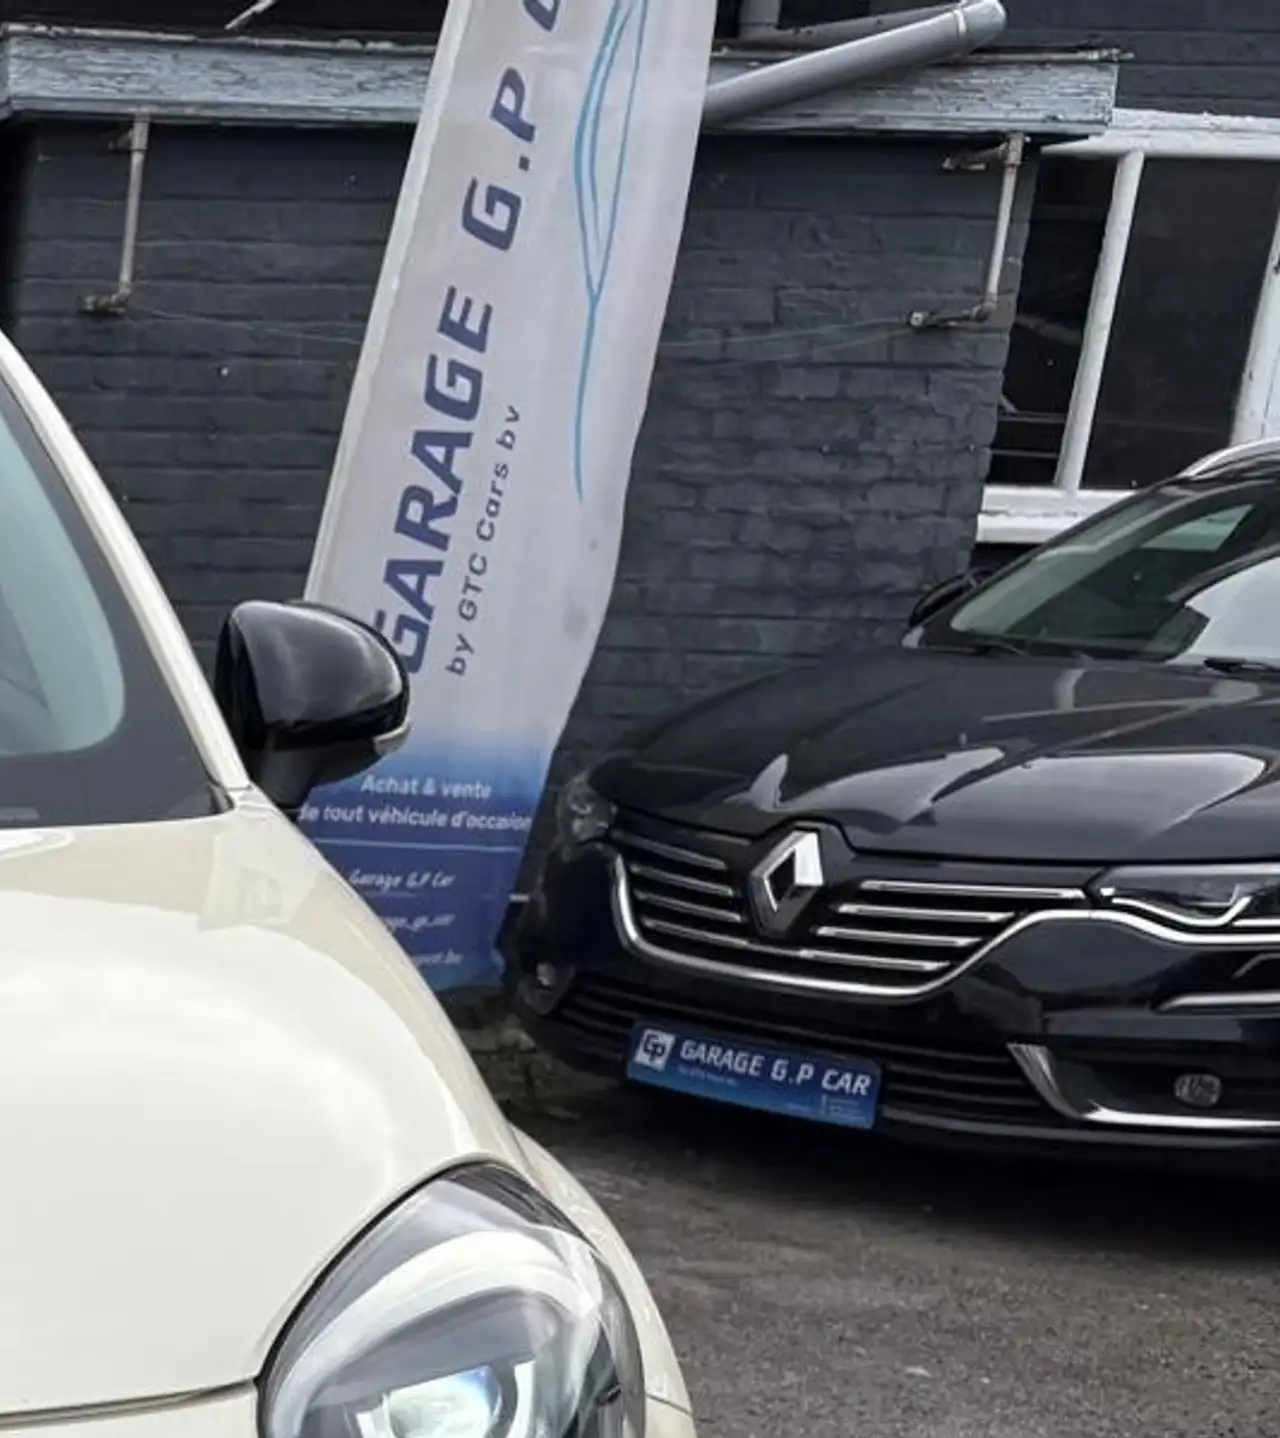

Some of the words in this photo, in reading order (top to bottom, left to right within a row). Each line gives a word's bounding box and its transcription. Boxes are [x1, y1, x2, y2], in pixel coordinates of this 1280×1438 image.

[374, 286, 493, 673] GARAGE
[462, 68, 536, 251] G.P
[496, 405, 521, 450] bv
[476, 462, 511, 541] Cars
[458, 552, 488, 622] GTC
[445, 634, 474, 677] by
[361, 774, 418, 796] Achat
[680, 1039, 765, 1076] GARAGE
[771, 1058, 815, 1086] G.P
[821, 1068, 872, 1096] CAR
